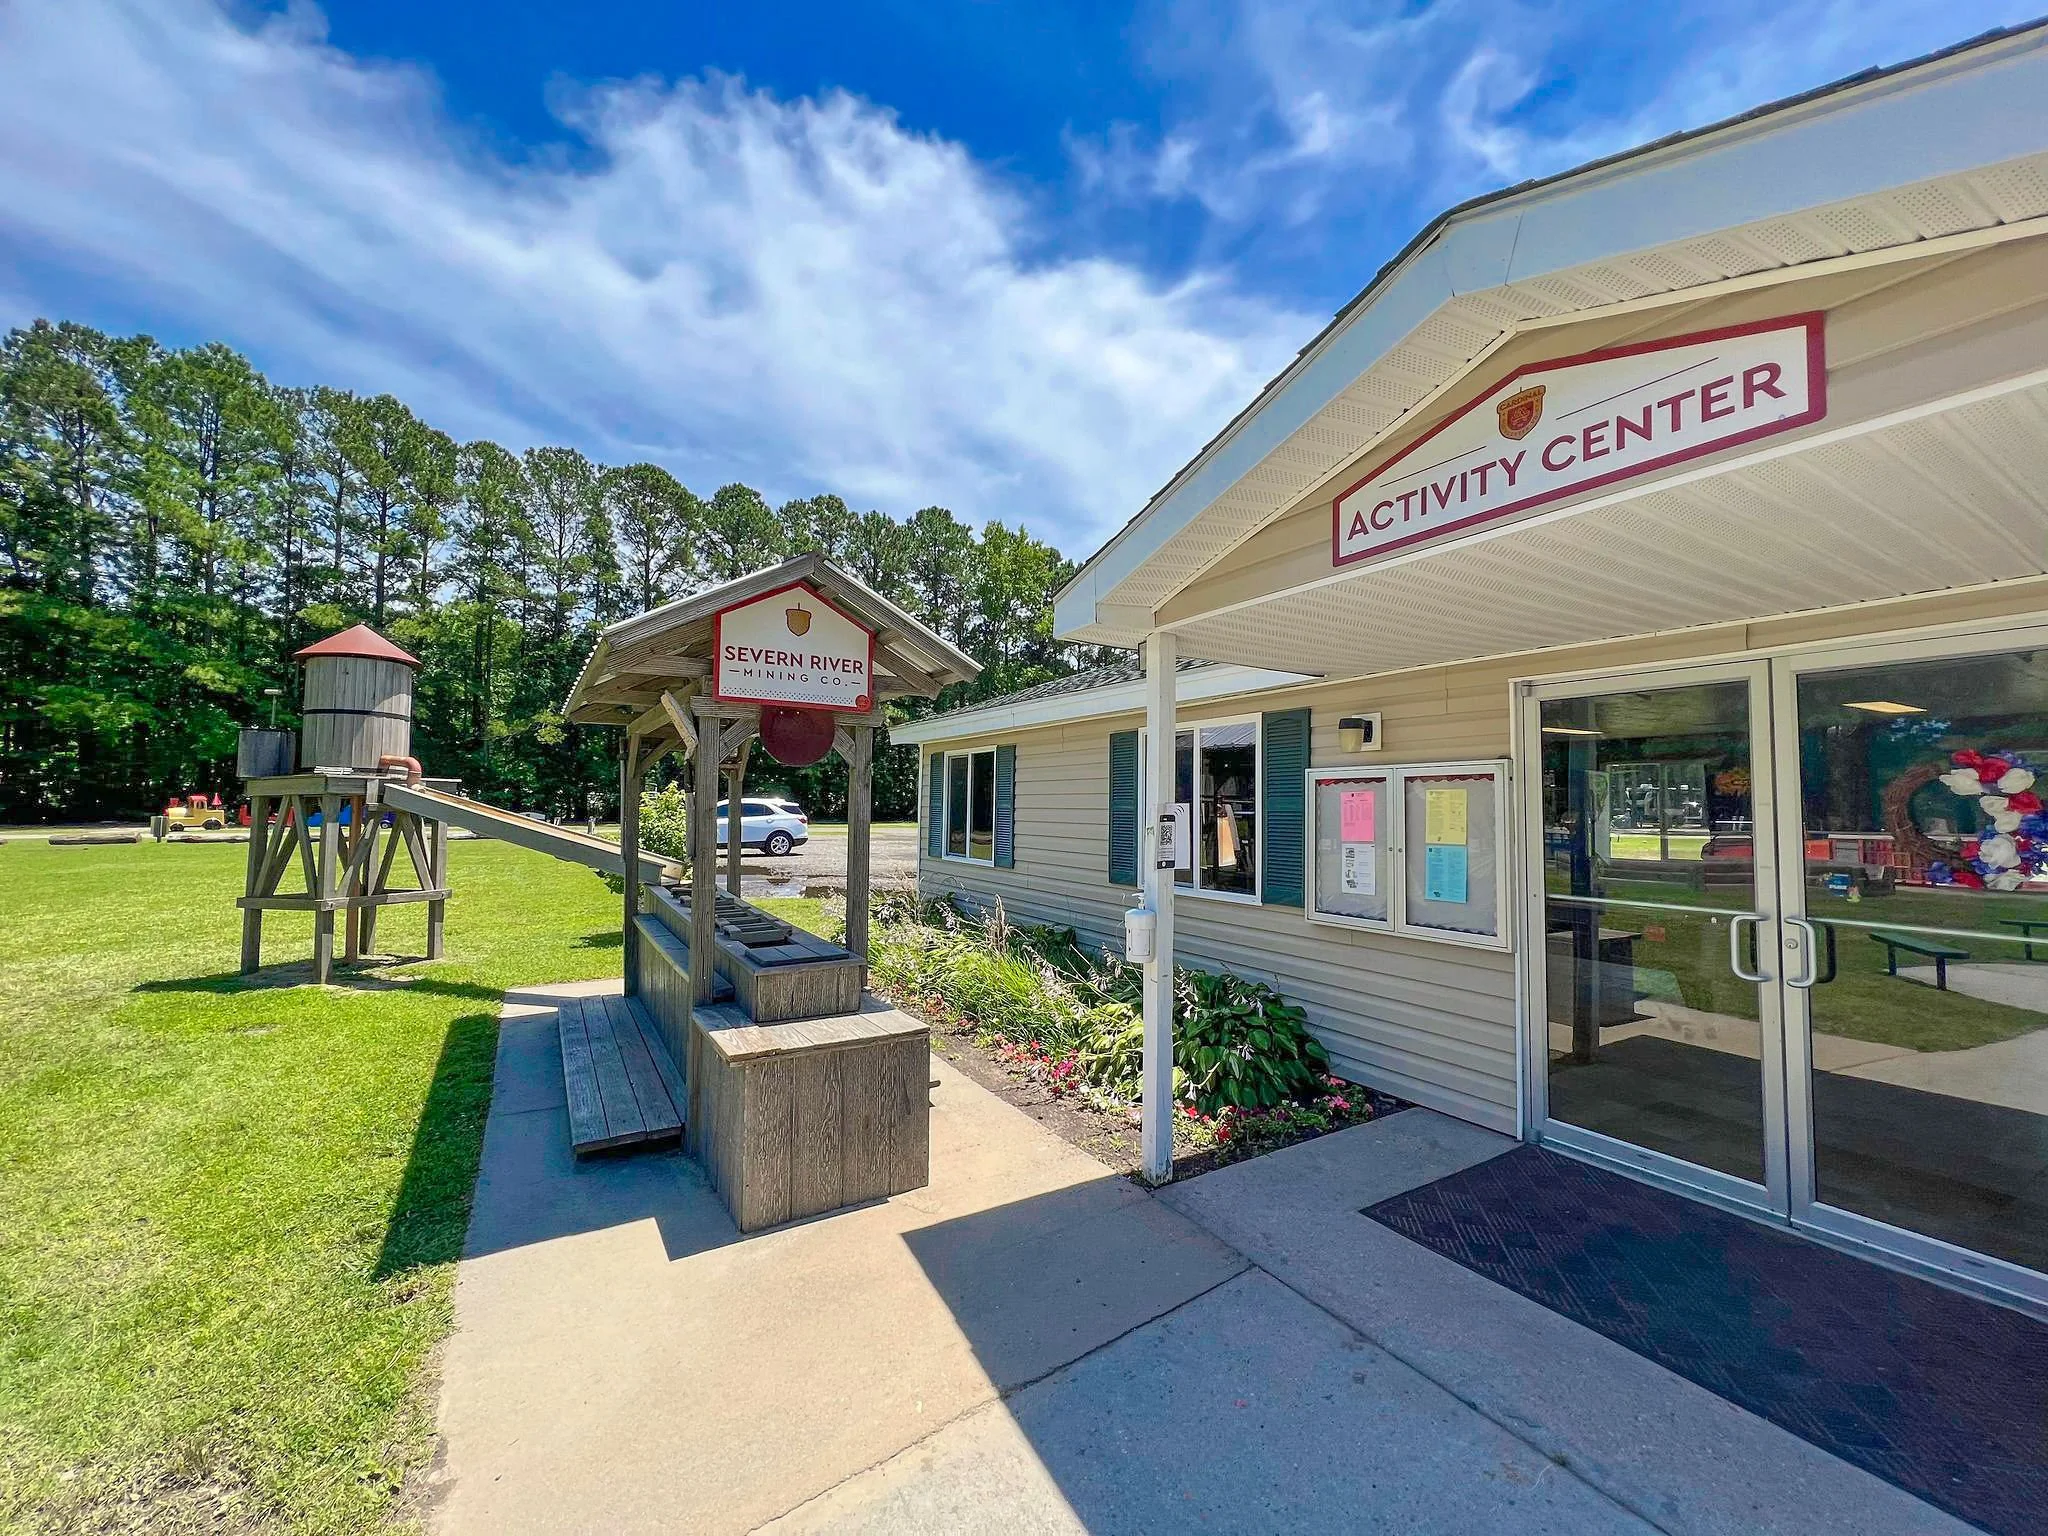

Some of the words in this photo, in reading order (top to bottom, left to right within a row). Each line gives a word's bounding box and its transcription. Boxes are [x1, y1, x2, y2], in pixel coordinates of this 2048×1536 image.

[1346, 449, 1527, 542] ACTIVITY
[1541, 362, 1787, 472] CENTER
[724, 645, 803, 668] SEVERN
[810, 654, 864, 675] RIVER
[743, 667, 809, 683] MINING
[820, 675, 848, 687] CO.
